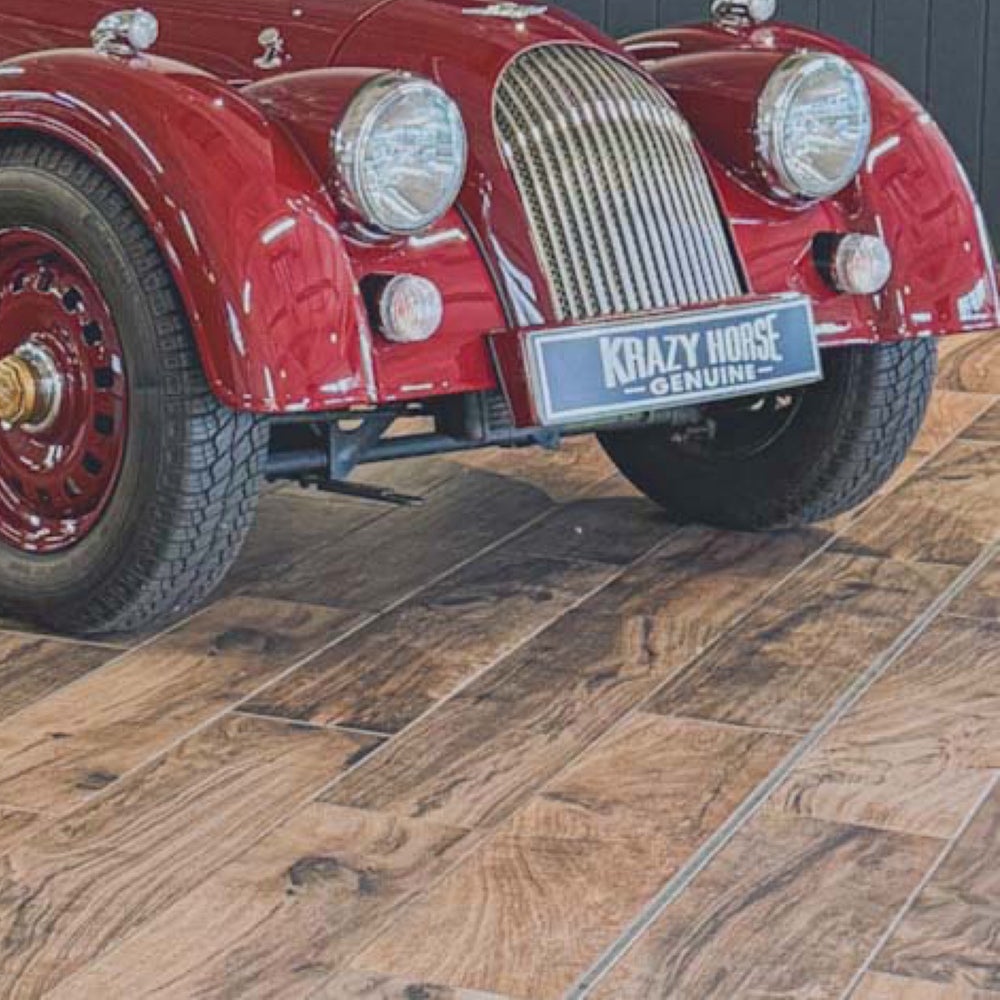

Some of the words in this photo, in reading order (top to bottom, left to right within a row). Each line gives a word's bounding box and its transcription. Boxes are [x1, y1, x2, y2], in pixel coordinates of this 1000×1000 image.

[600, 332, 699, 389] KRAZY
[706, 313, 783, 365] HORSE
[649, 364, 756, 395] GENUINE
